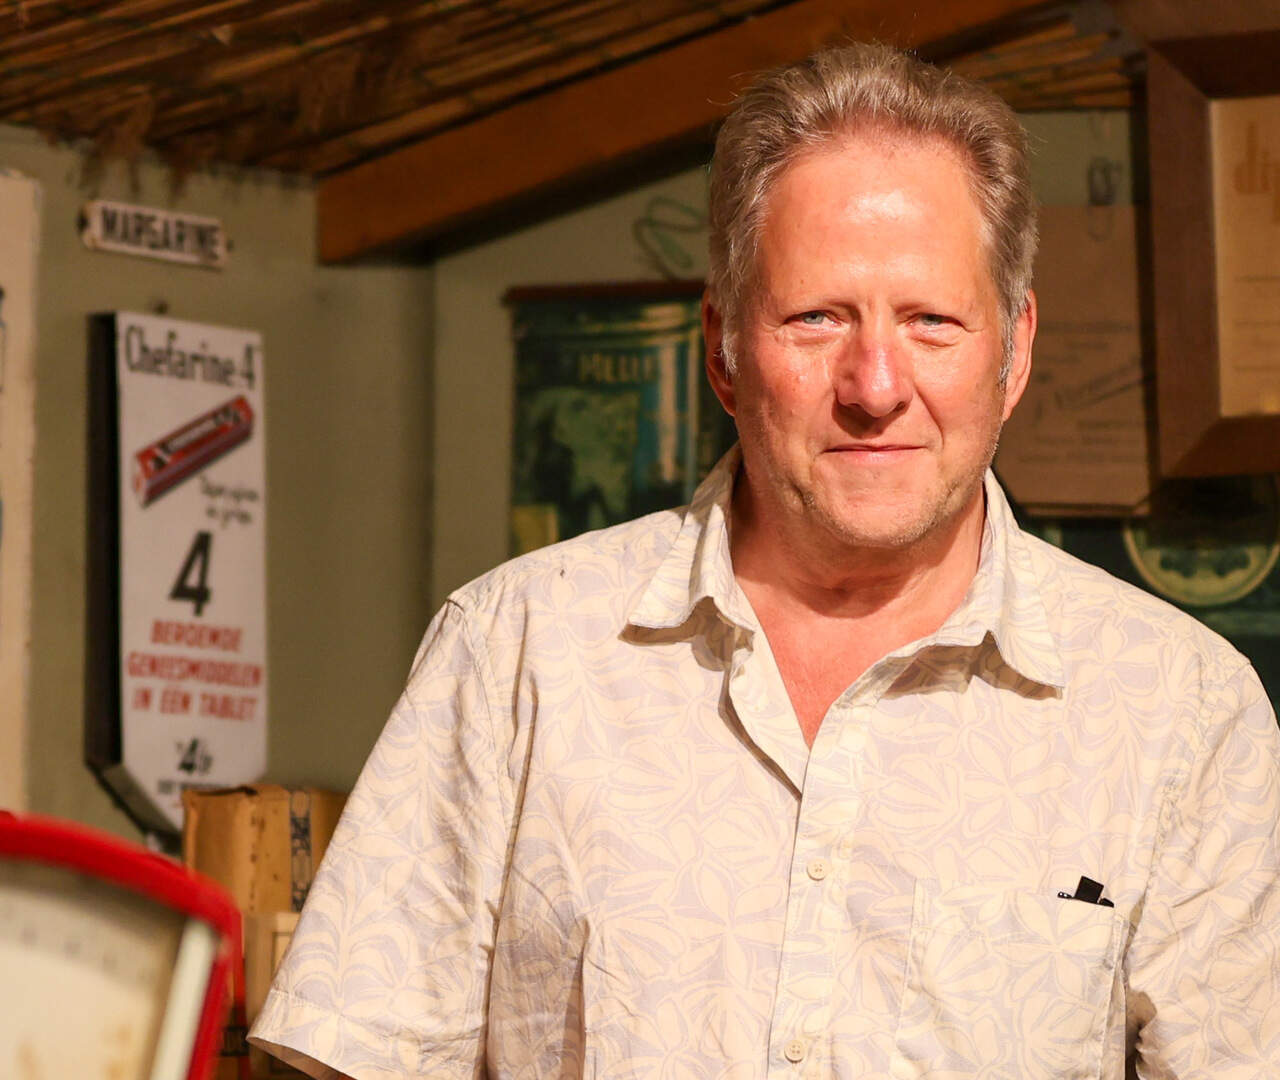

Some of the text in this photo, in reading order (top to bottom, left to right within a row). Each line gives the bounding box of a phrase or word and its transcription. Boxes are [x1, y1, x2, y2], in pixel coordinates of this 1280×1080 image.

[101, 206, 221, 261] MARGARINE
[169, 530, 213, 617] 4
[151, 619, 243, 652] BEROEMDE
[128, 652, 263, 688] GENEESMIDDELEN
[132, 687, 152, 711] IN
[199, 691, 257, 721] TABLET
